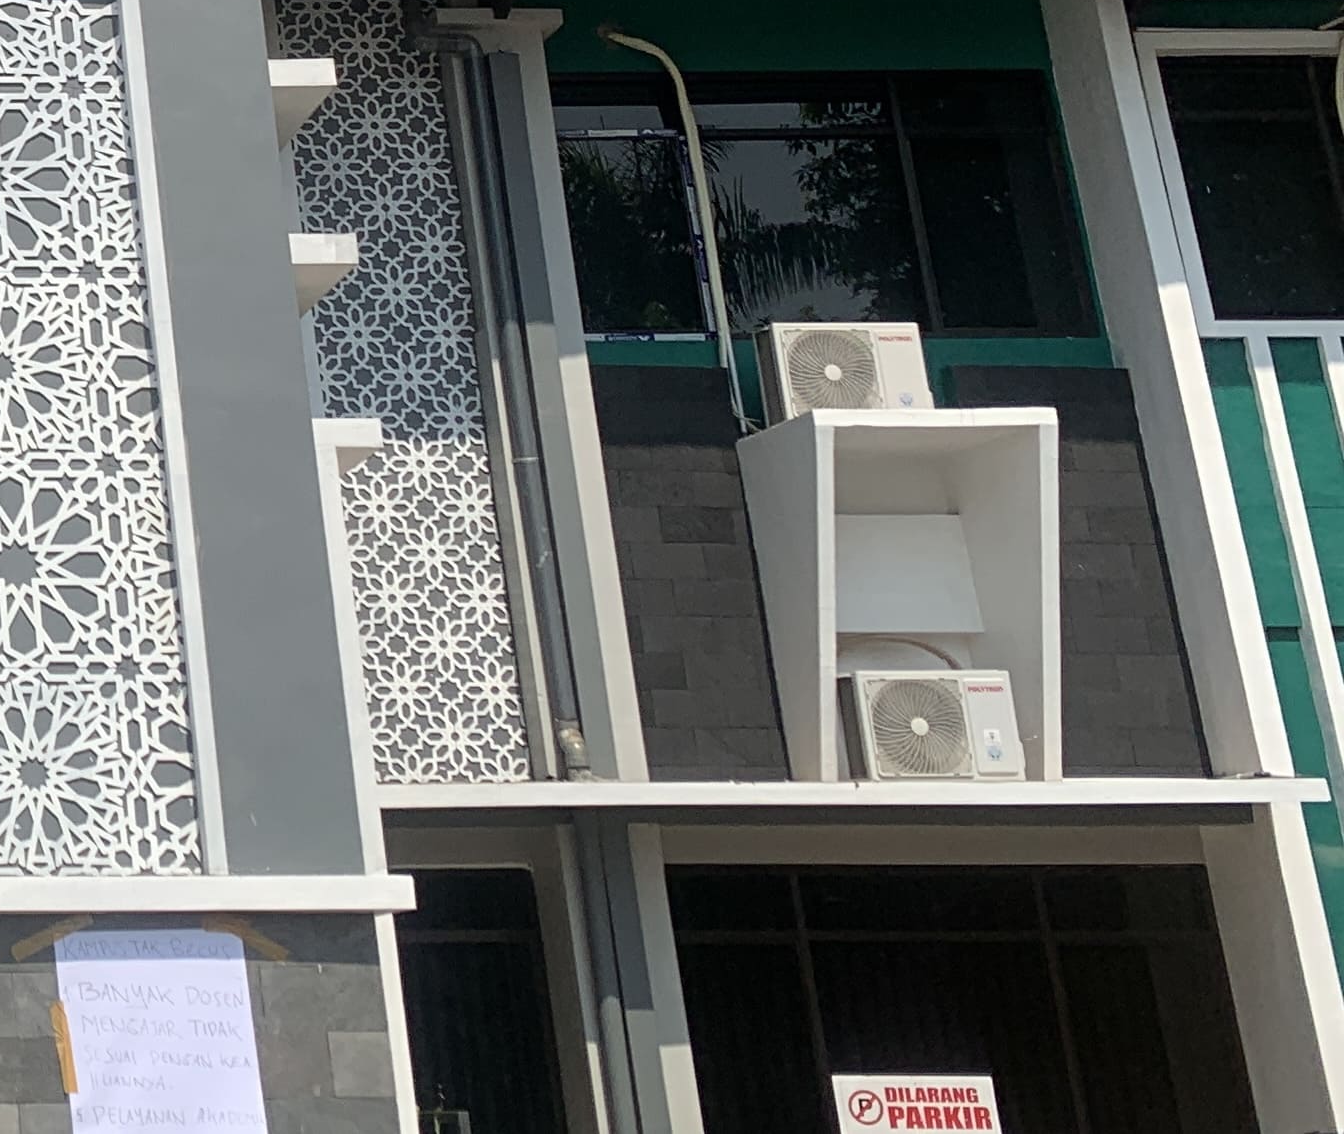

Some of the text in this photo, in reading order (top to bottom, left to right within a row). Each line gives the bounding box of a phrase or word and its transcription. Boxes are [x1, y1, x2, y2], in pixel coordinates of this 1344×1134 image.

[78, 981, 176, 1010] BANYAK
[184, 985, 244, 1008] DOSEN
[81, 1015, 243, 1041] MENGAJAR TIDAK
[150, 1049, 213, 1068] DENGAN
[884, 1087, 979, 1104] DILARANG
[92, 1105, 186, 1126] PELAYANAN
[888, 1106, 993, 1129] PARKIR
